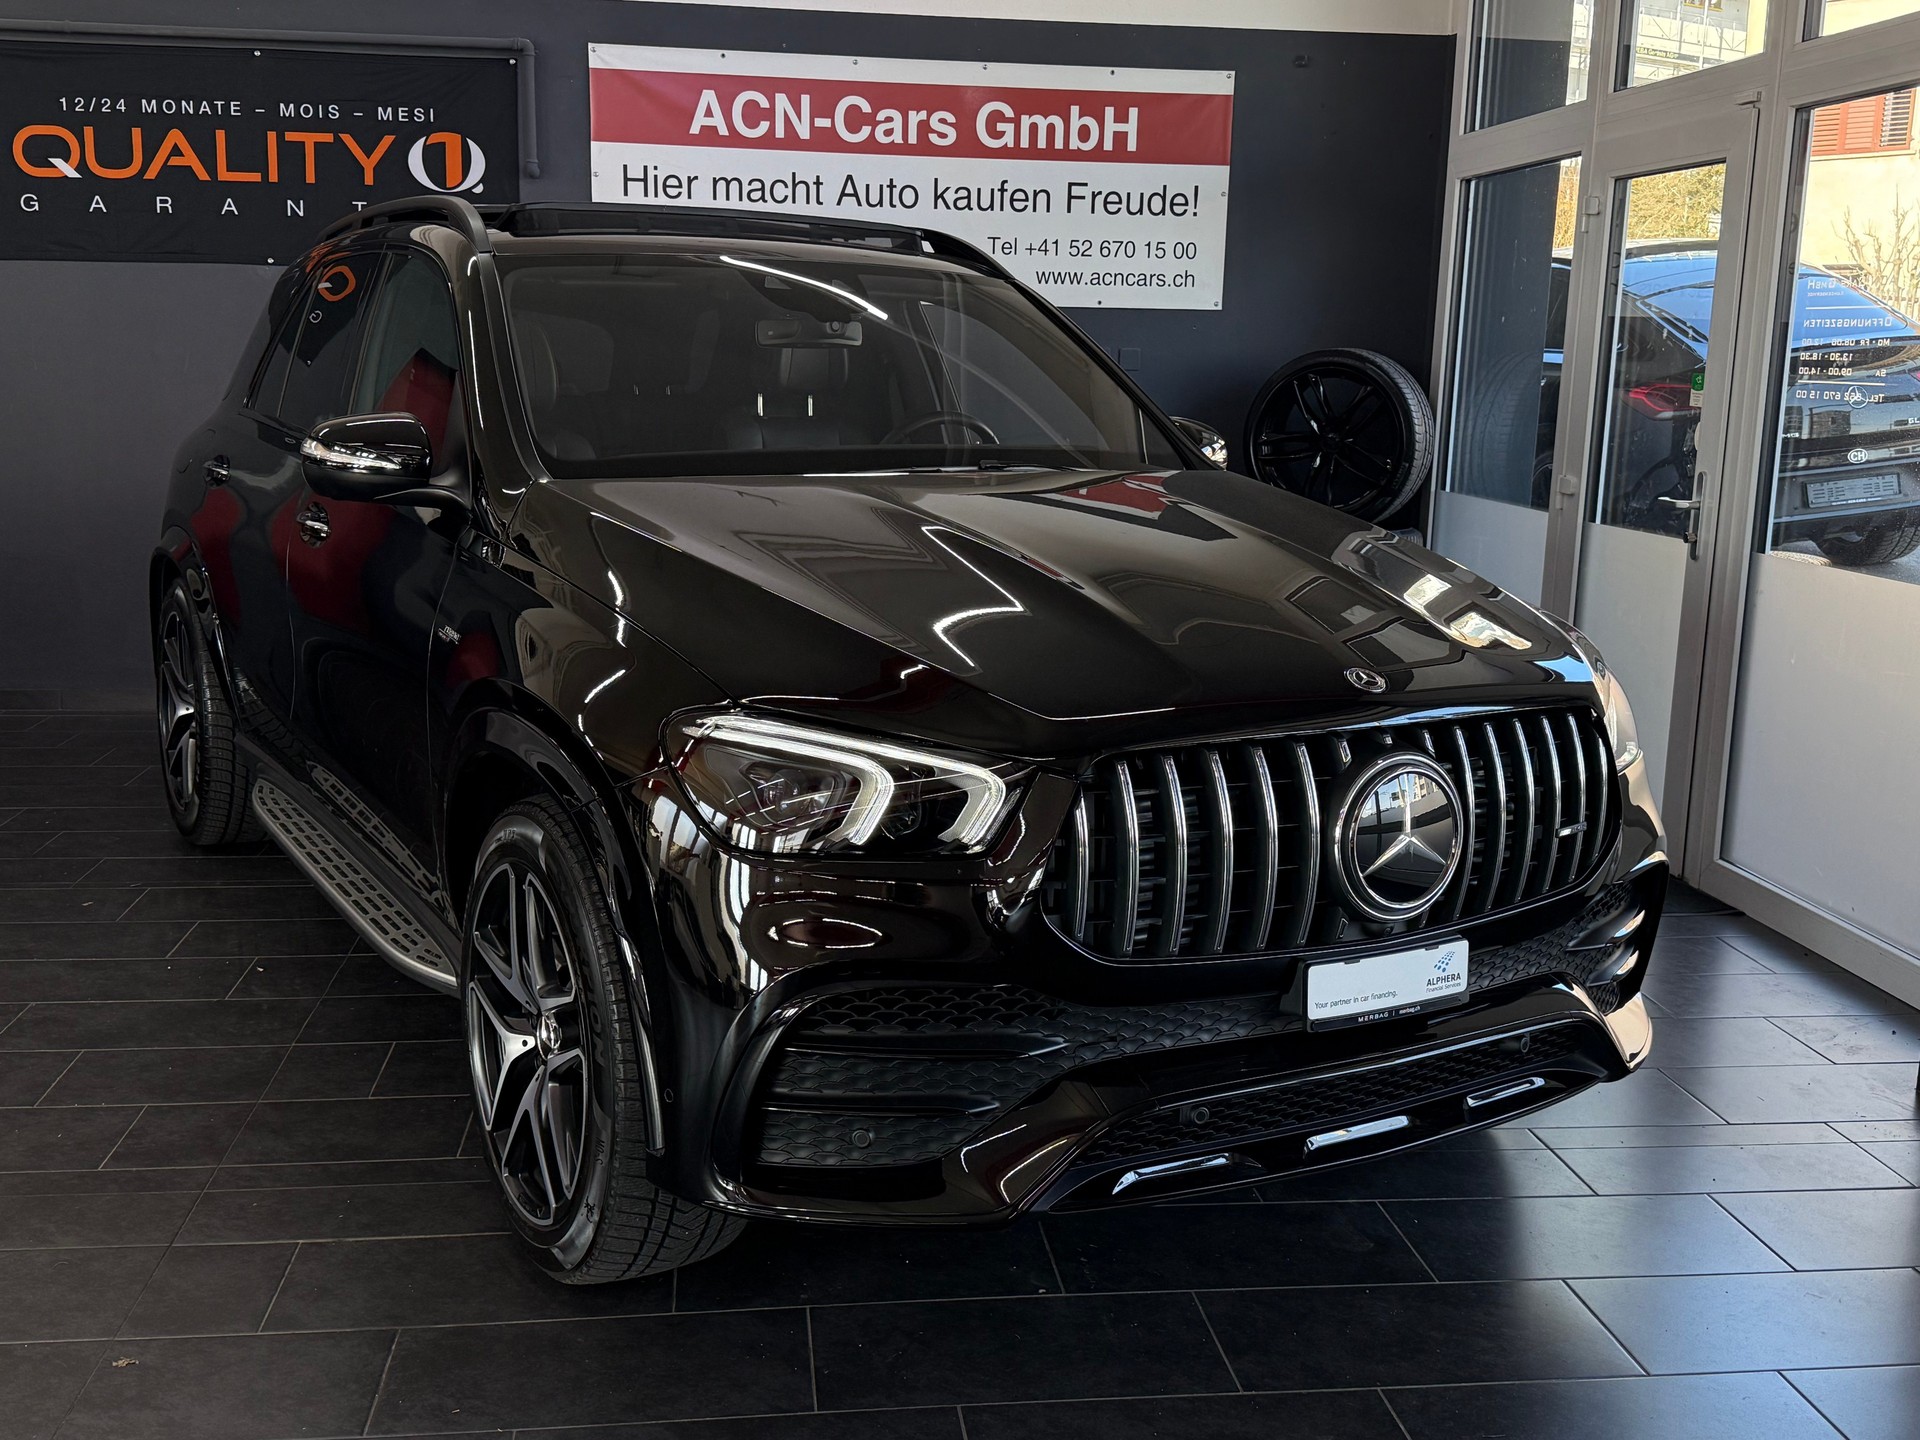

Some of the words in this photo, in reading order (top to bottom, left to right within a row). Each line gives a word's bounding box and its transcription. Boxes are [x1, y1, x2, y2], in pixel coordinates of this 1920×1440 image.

[59, 97, 127, 113] 12/24
[141, 99, 242, 116] MONATE
[279, 102, 340, 119] MOIS
[377, 107, 435, 122] MESI
[689, 89, 957, 147] ACN-Cars
[975, 101, 1139, 152] GmbH
[12, 124, 397, 186] QUALITY
[622, 164, 698, 199] Hier
[712, 171, 823, 205] macht
[836, 174, 920, 209] Auto
[933, 177, 1051, 213] kaufen
[1066, 181, 1200, 217] Freude!
[20, 193, 367, 216] GARANT
[987, 236, 1018, 256] Tel
[1024, 238, 1059, 257] +41
[1068, 239, 1093, 258] 52
[1099, 240, 1136, 259] 670
[1144, 241, 1166, 259] 15
[1173, 241, 1198, 260] 00
[1035, 270, 1195, 288] www.acncars.ch
[1850, 451, 1865, 461] CH
[1425, 985, 1444, 993] Financial
[1444, 982, 1461, 990] Services
[1426, 973, 1461, 987] ALPHERA
[1314, 1001, 1329, 1009] Your
[1329, 997, 1352, 1008] partner
[1370, 990, 1398, 1001] financing.
[1358, 1011, 1389, 1022] MERBAG
